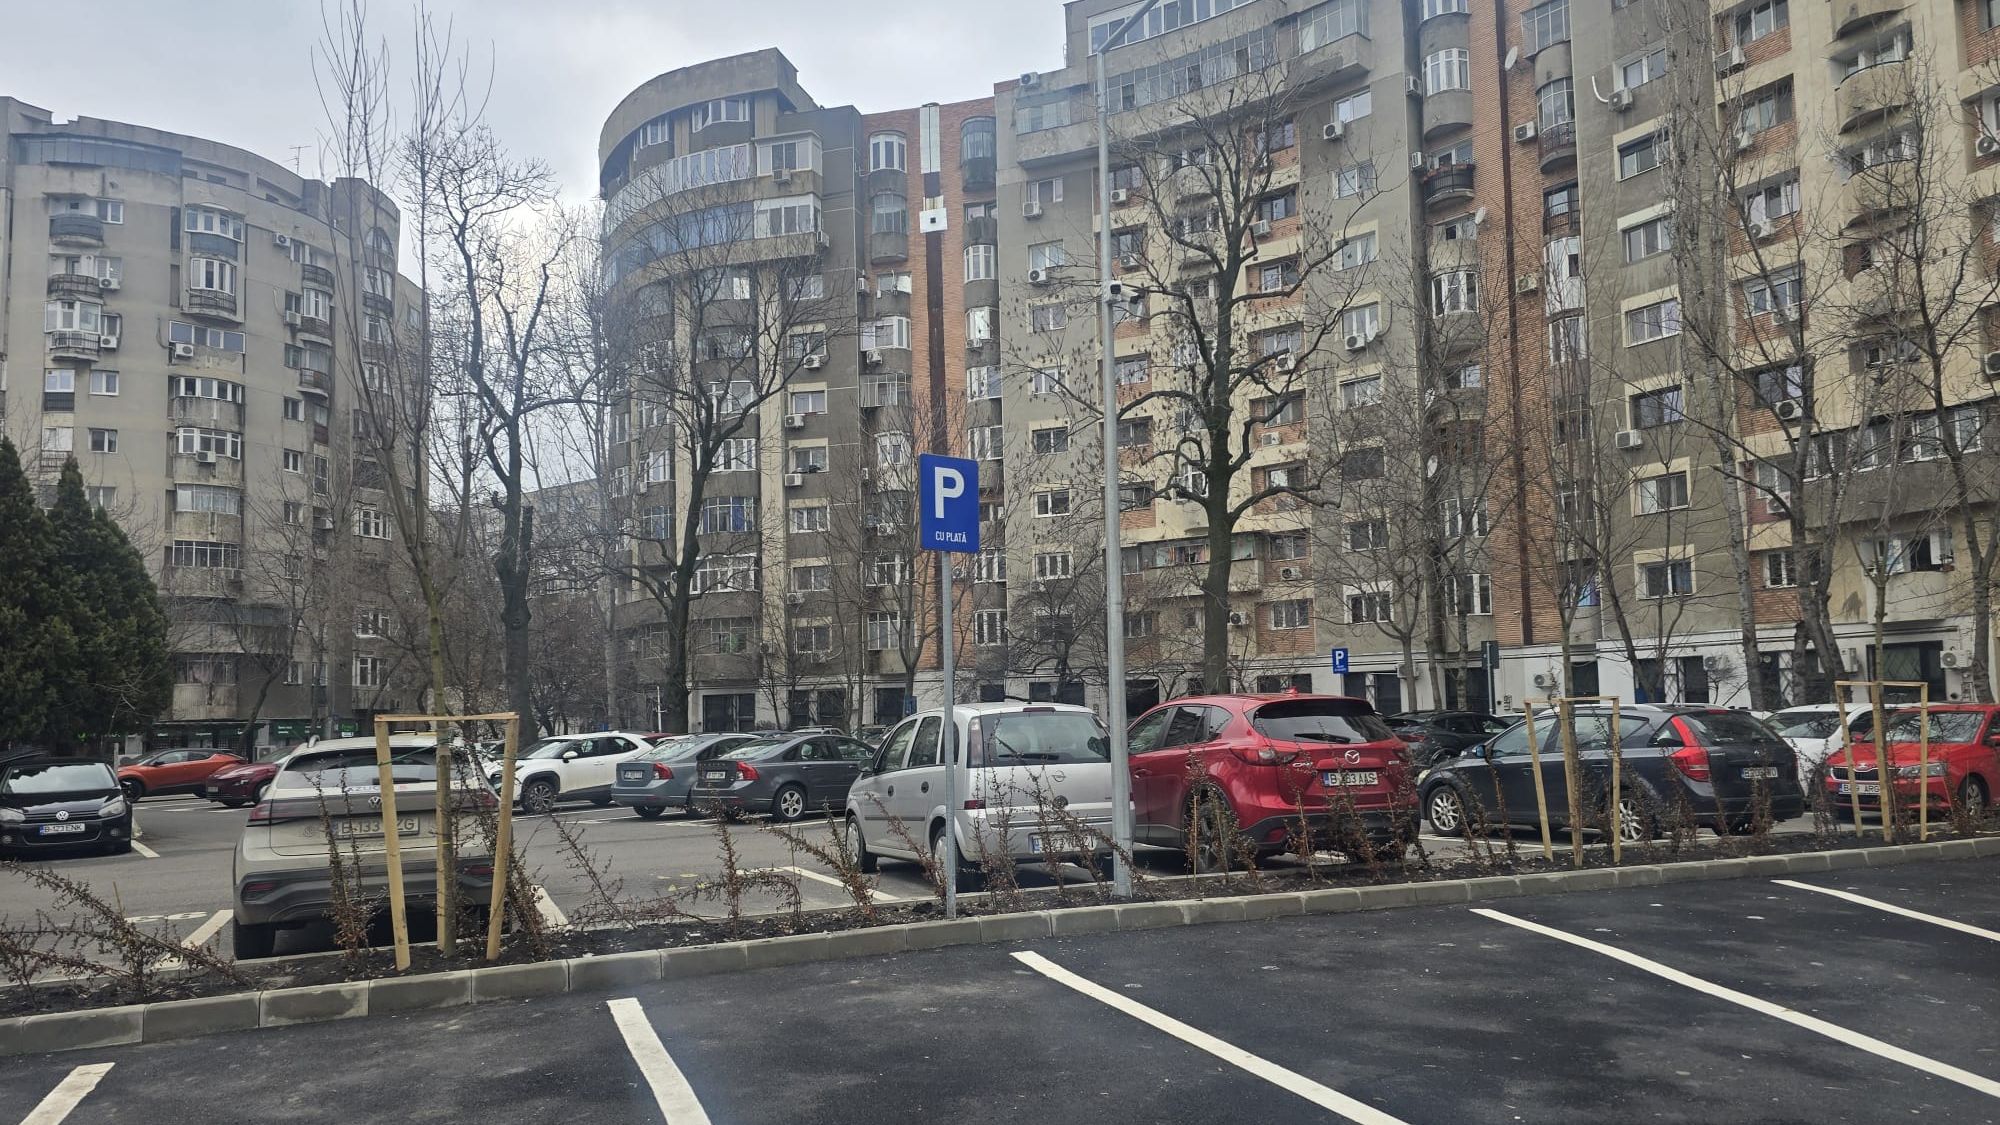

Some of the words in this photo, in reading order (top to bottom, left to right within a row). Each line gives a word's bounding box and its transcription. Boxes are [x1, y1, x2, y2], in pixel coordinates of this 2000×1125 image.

[935, 467, 965, 518] P
[935, 530, 945, 541] CU
[946, 532, 967, 543] PLATĂ
[1335, 650, 1345, 666] P
[1330, 774, 1337, 784] B
[1843, 784, 1849, 792] B
